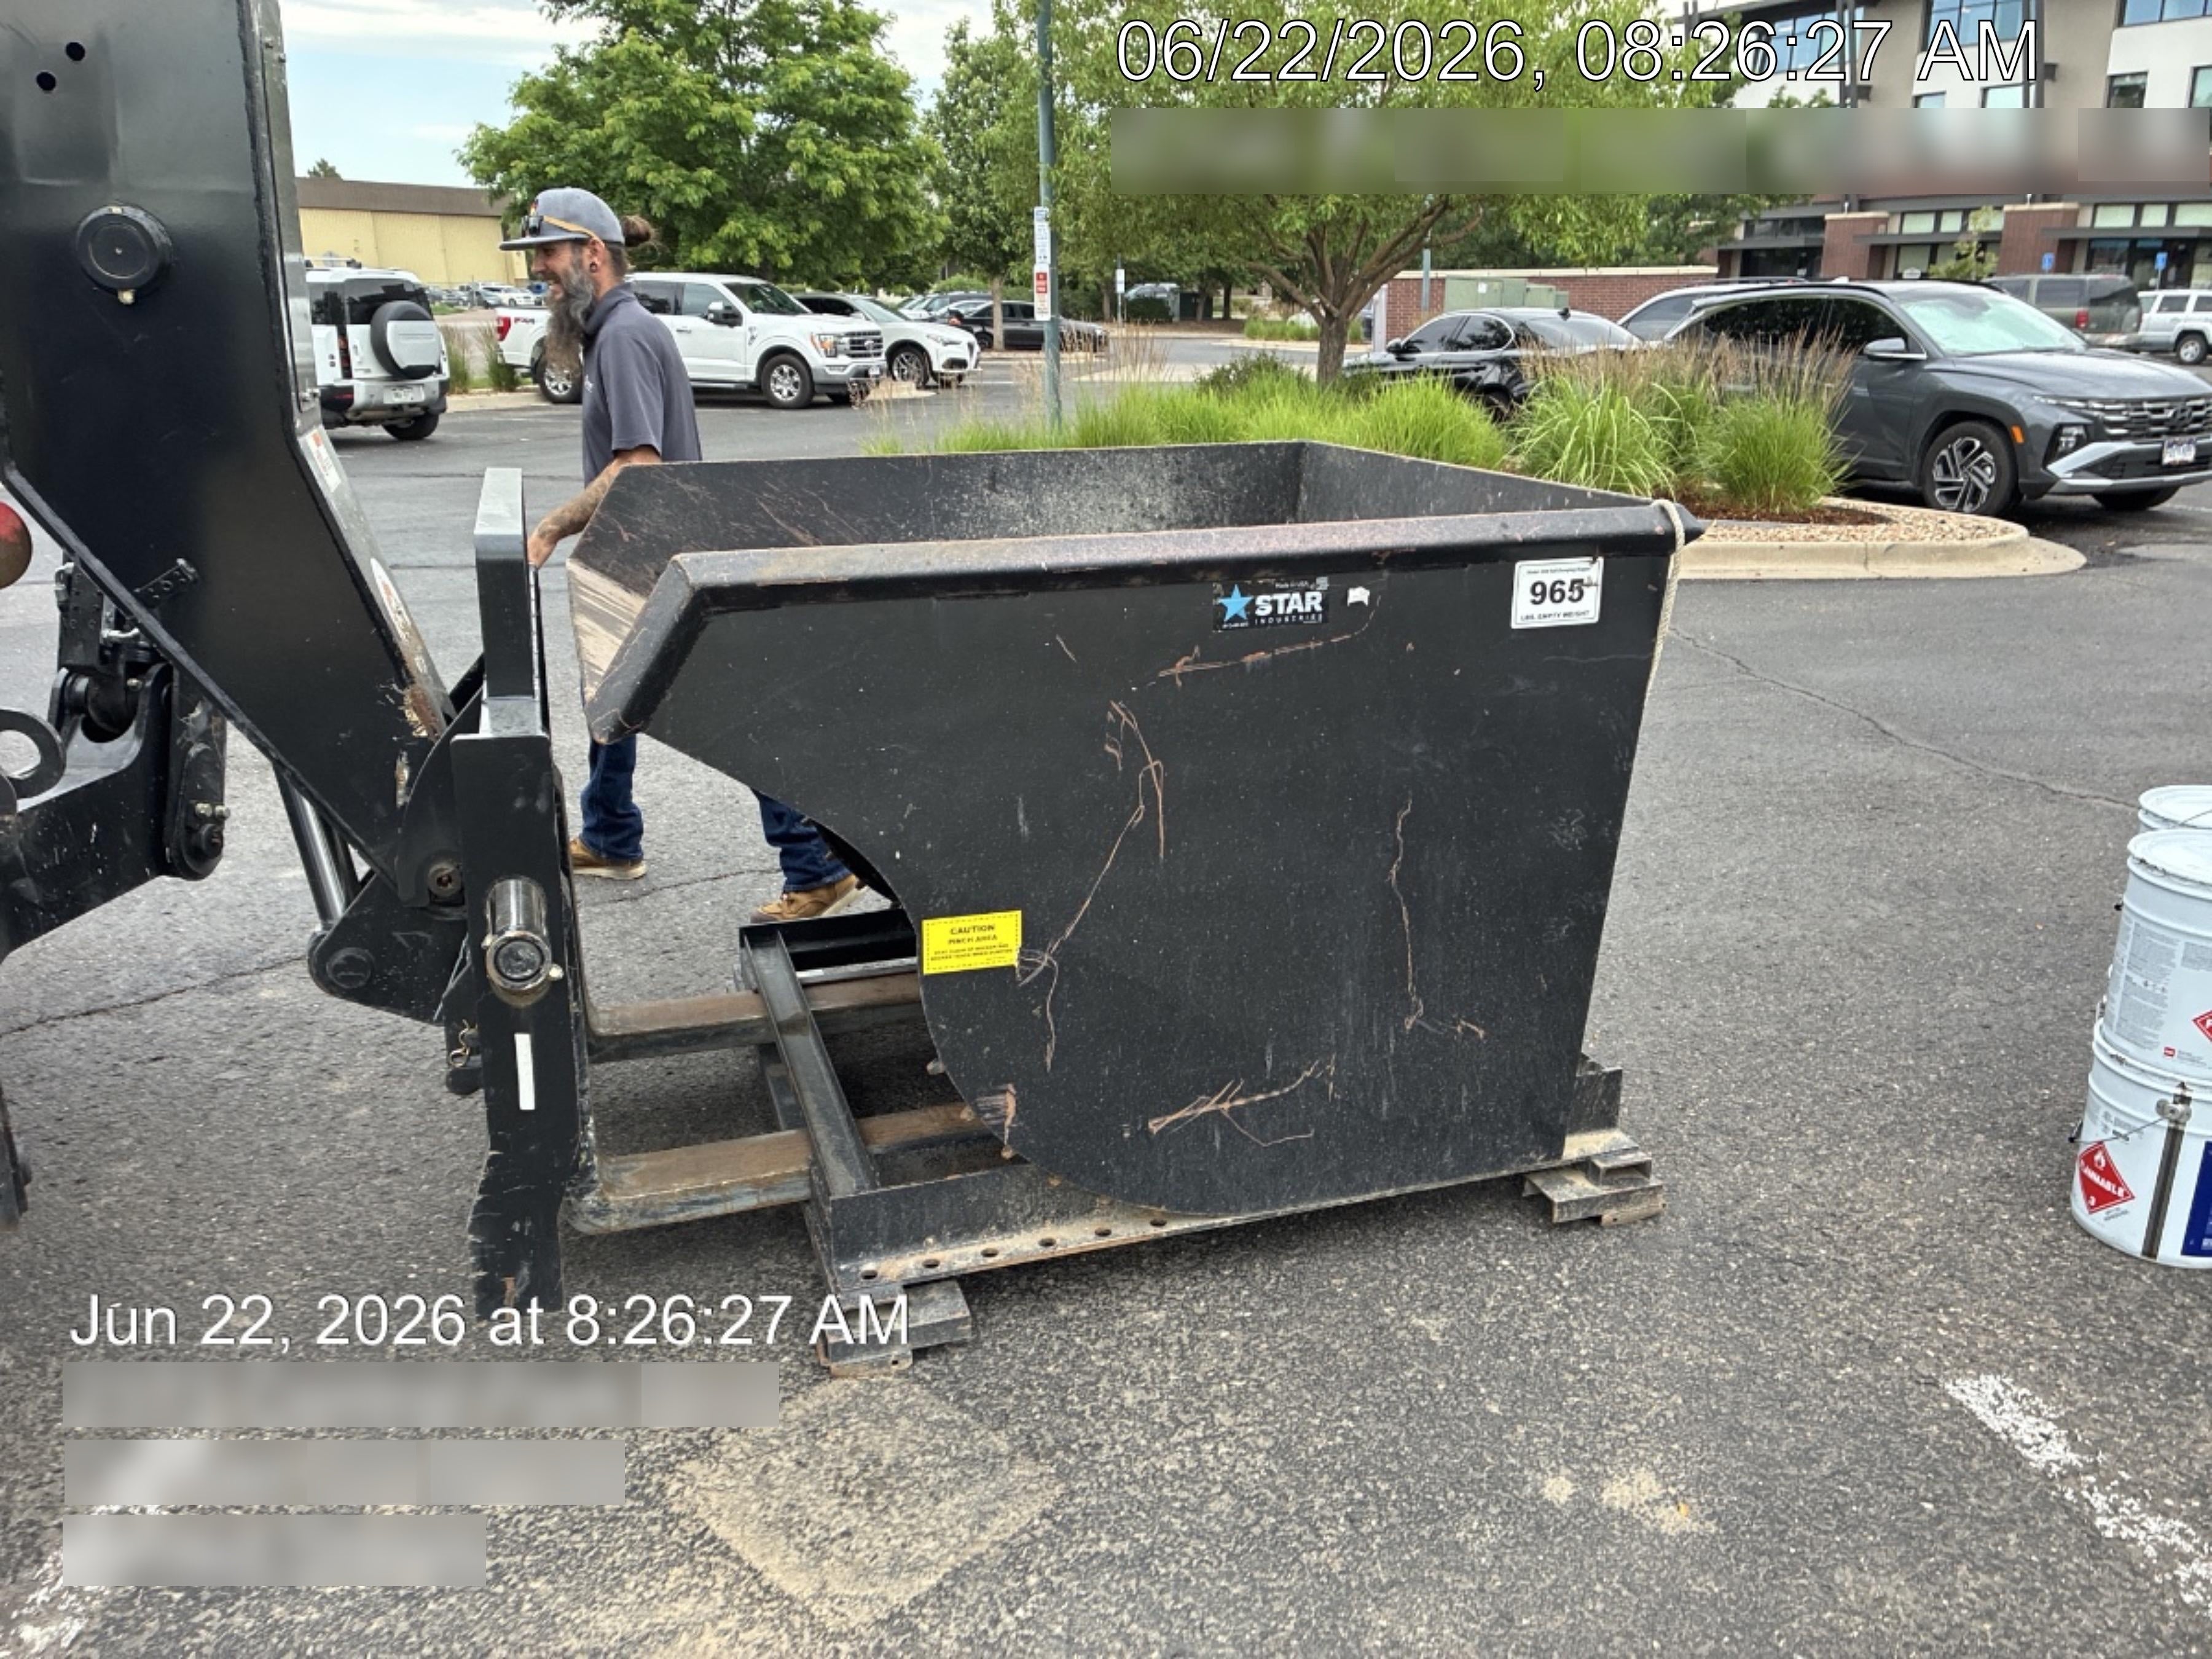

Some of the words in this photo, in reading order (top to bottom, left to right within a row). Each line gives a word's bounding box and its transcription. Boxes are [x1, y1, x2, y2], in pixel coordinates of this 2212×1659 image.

[1255, 591, 1323, 616] STAR
[1530, 578, 1585, 605] 965
[950, 924, 995, 935] CAUTION
